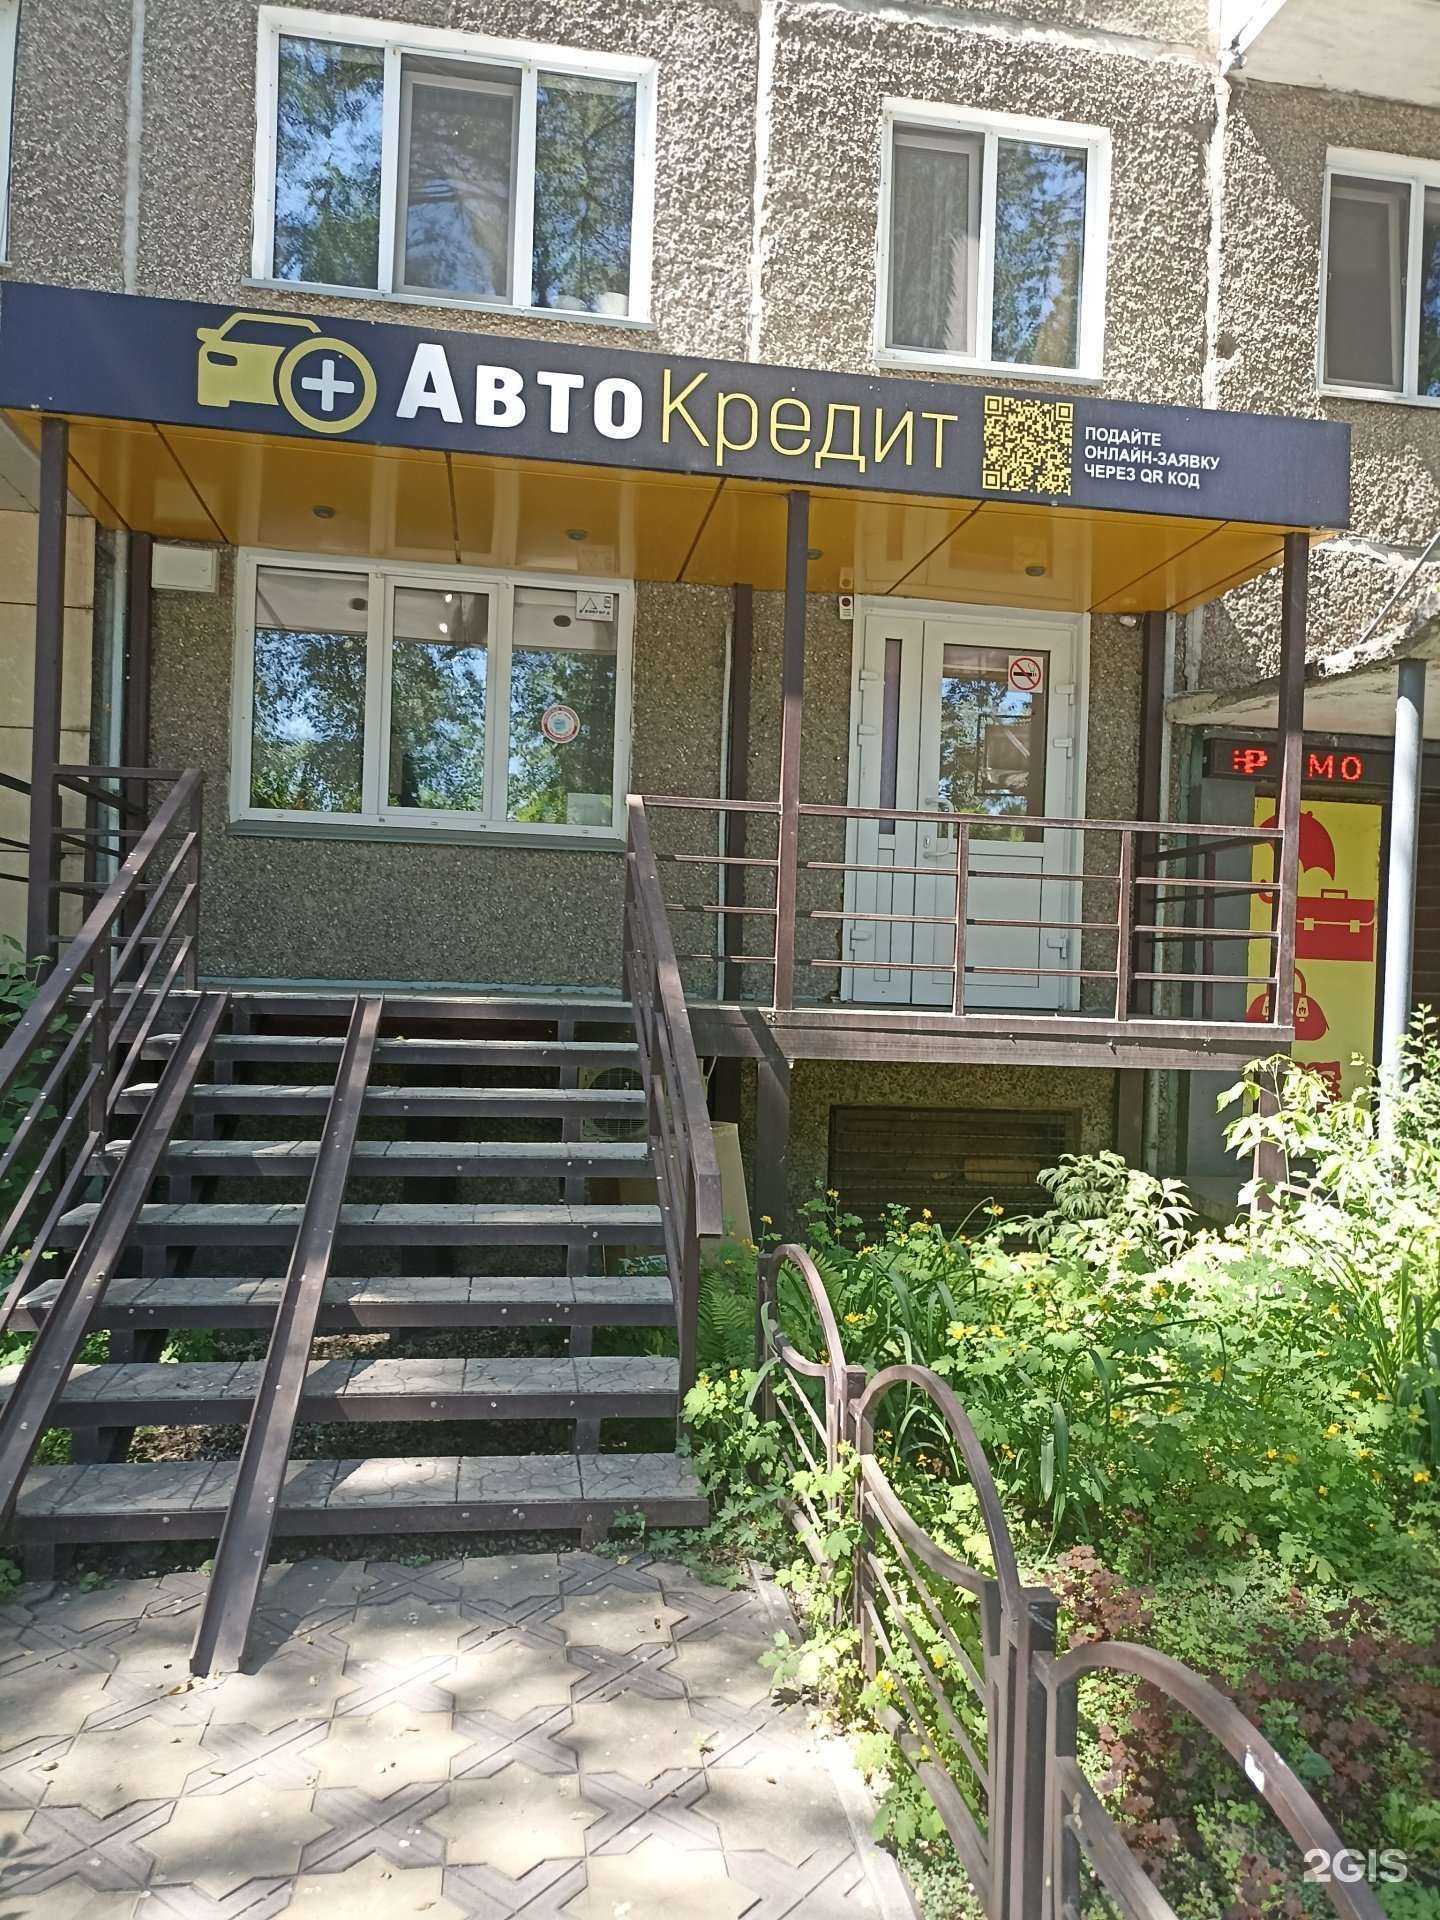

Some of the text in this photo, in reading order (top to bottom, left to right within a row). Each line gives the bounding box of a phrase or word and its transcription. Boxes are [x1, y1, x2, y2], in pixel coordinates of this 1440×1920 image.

[1084, 426, 1162, 447] ПОДАЙТЕ
[1084, 445, 1220, 471] ОНЛАЙН-ЗАЯВКУ
[1084, 463, 1200, 490] ЧЕРЕЗ QR КОД
